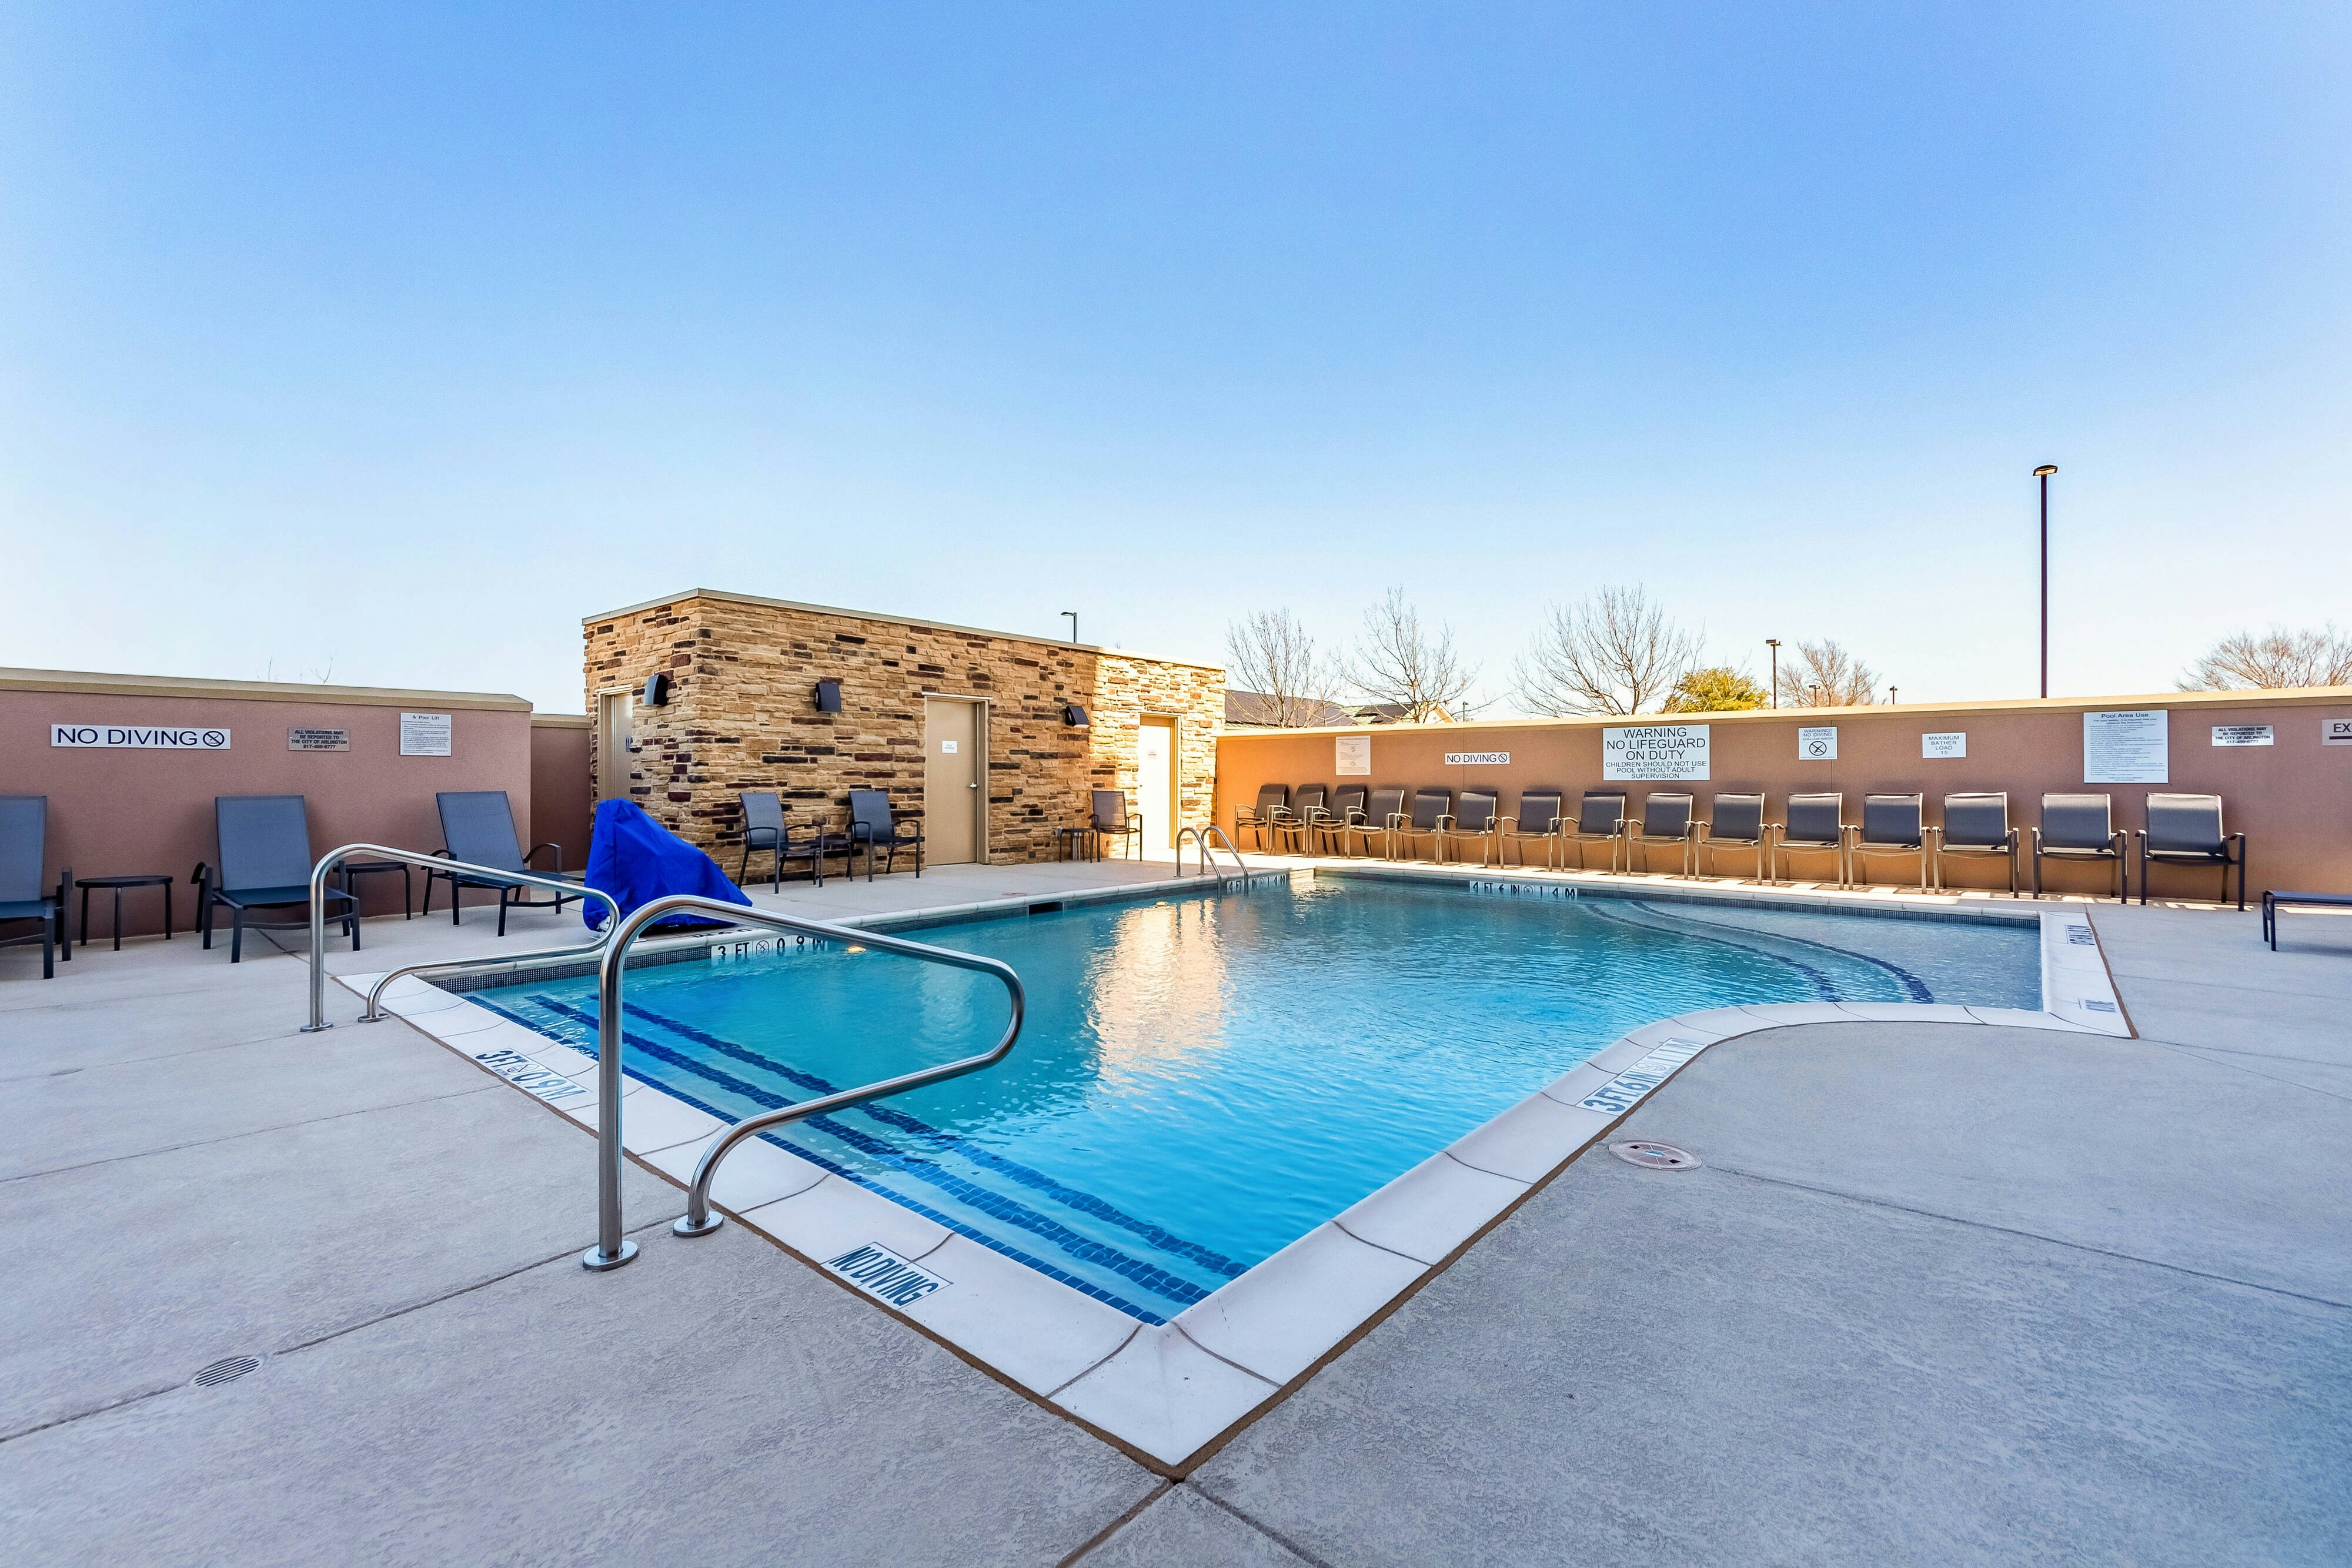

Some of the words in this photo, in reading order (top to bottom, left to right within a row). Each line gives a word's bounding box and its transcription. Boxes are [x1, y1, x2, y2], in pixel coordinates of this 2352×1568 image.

[58, 728, 98, 744] NO
[108, 729, 198, 745] DIVING
[1623, 727, 1687, 738] WARNING
[1607, 740, 1625, 750] NO
[1629, 738, 1706, 750] LIFEGUARD
[1464, 754, 1496, 763] DIVING
[1626, 751, 1645, 760] ON
[1649, 750, 1685, 760] DUTY
[736, 942, 750, 959] FT
[828, 1246, 883, 1272] NO
[850, 1258, 938, 1306] DIVING
